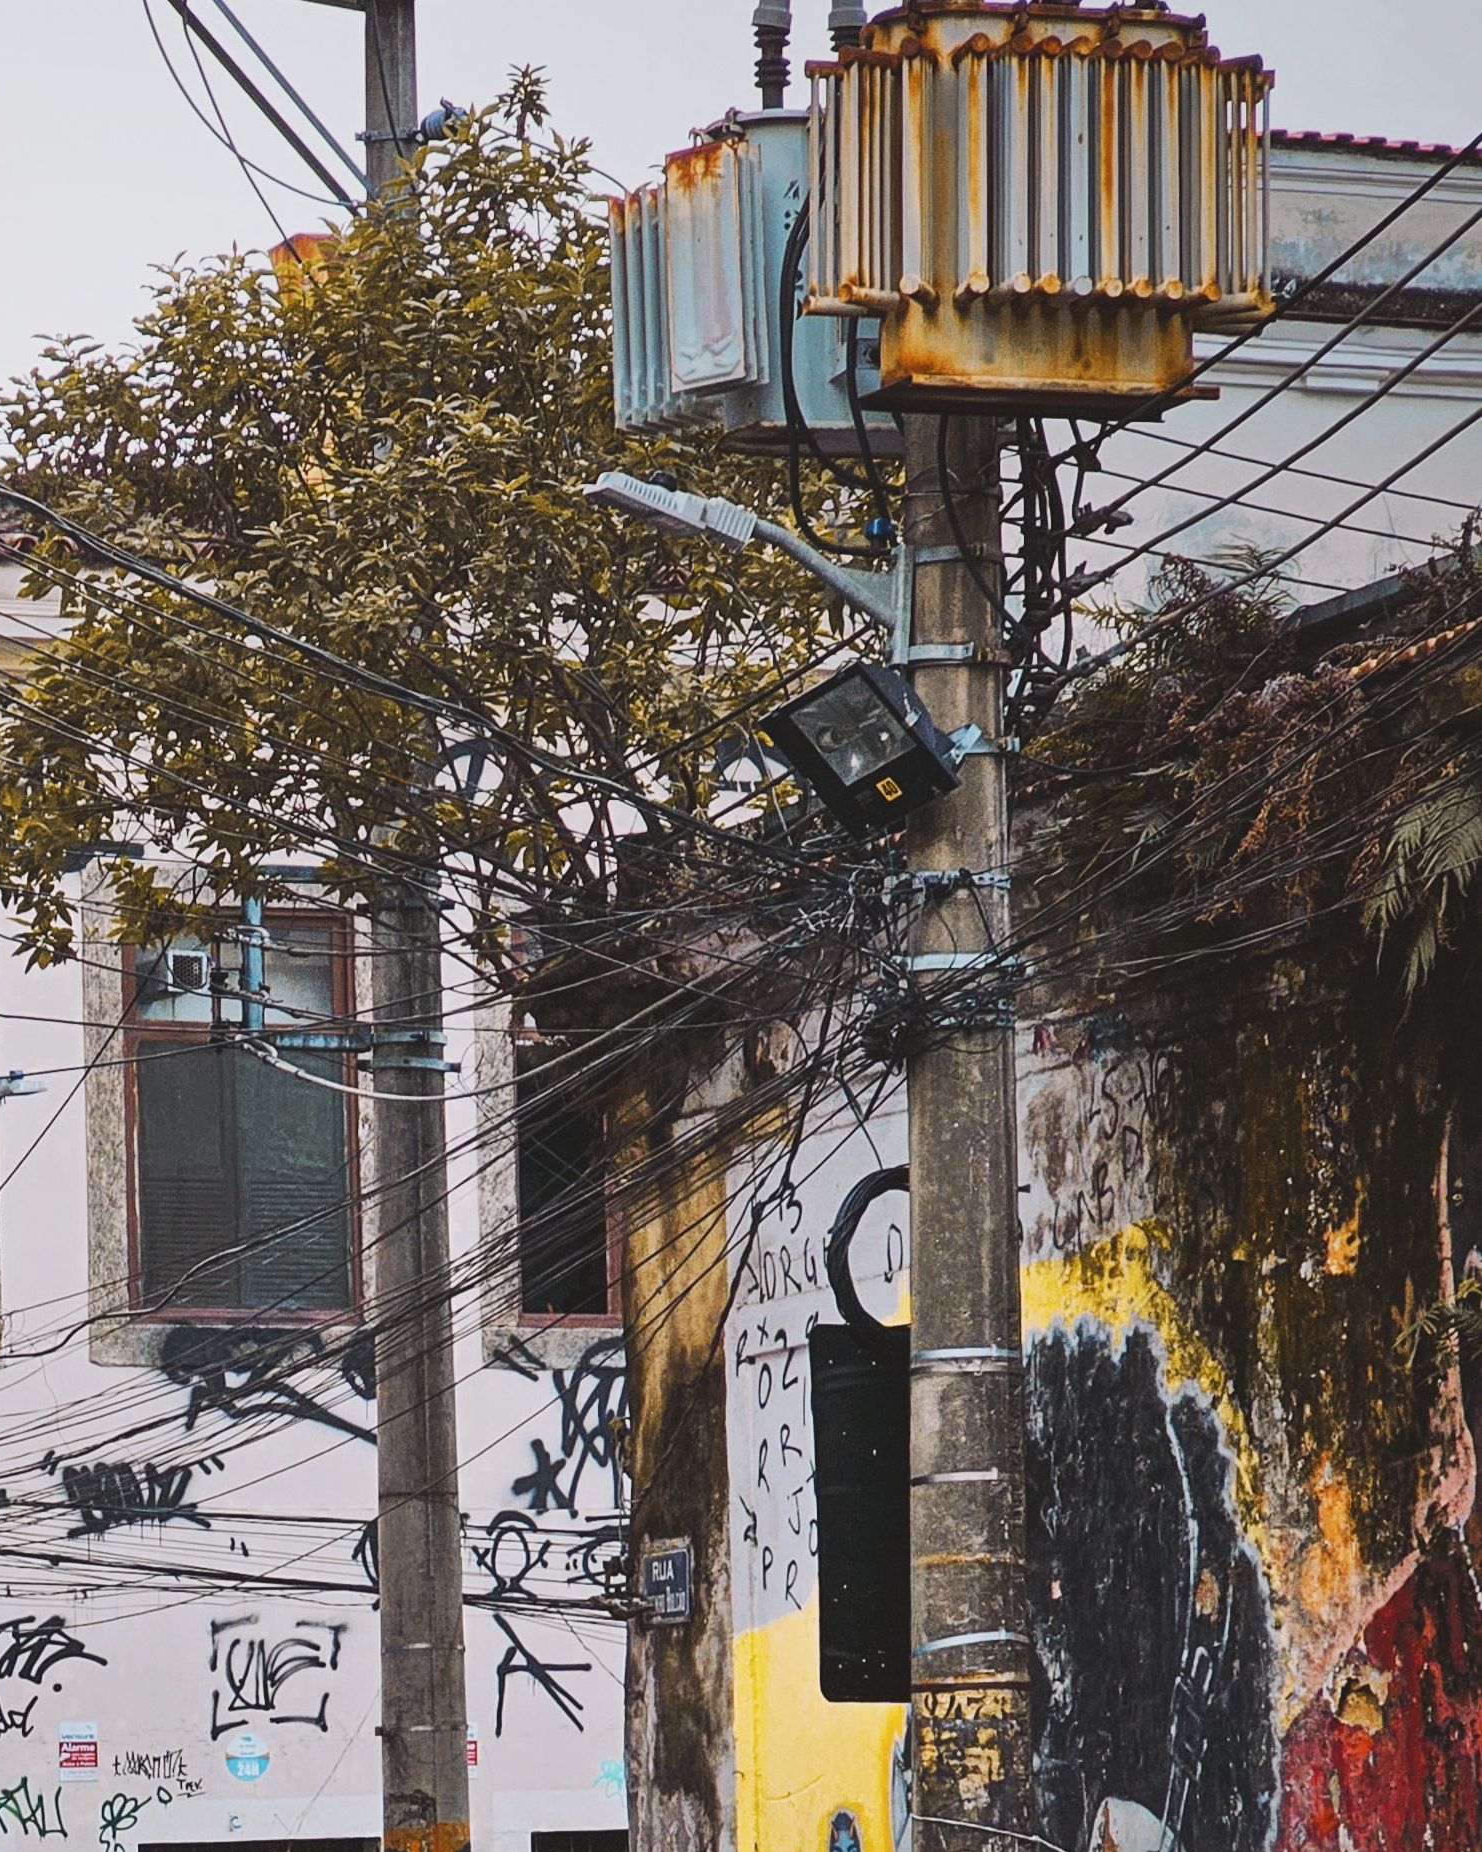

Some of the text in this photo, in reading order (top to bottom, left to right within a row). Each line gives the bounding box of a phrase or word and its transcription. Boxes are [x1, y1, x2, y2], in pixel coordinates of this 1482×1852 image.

[652, 1560, 674, 1582] RUA
[61, 1743, 95, 1752] Alarme
[237, 1760, 260, 1776] 24H
